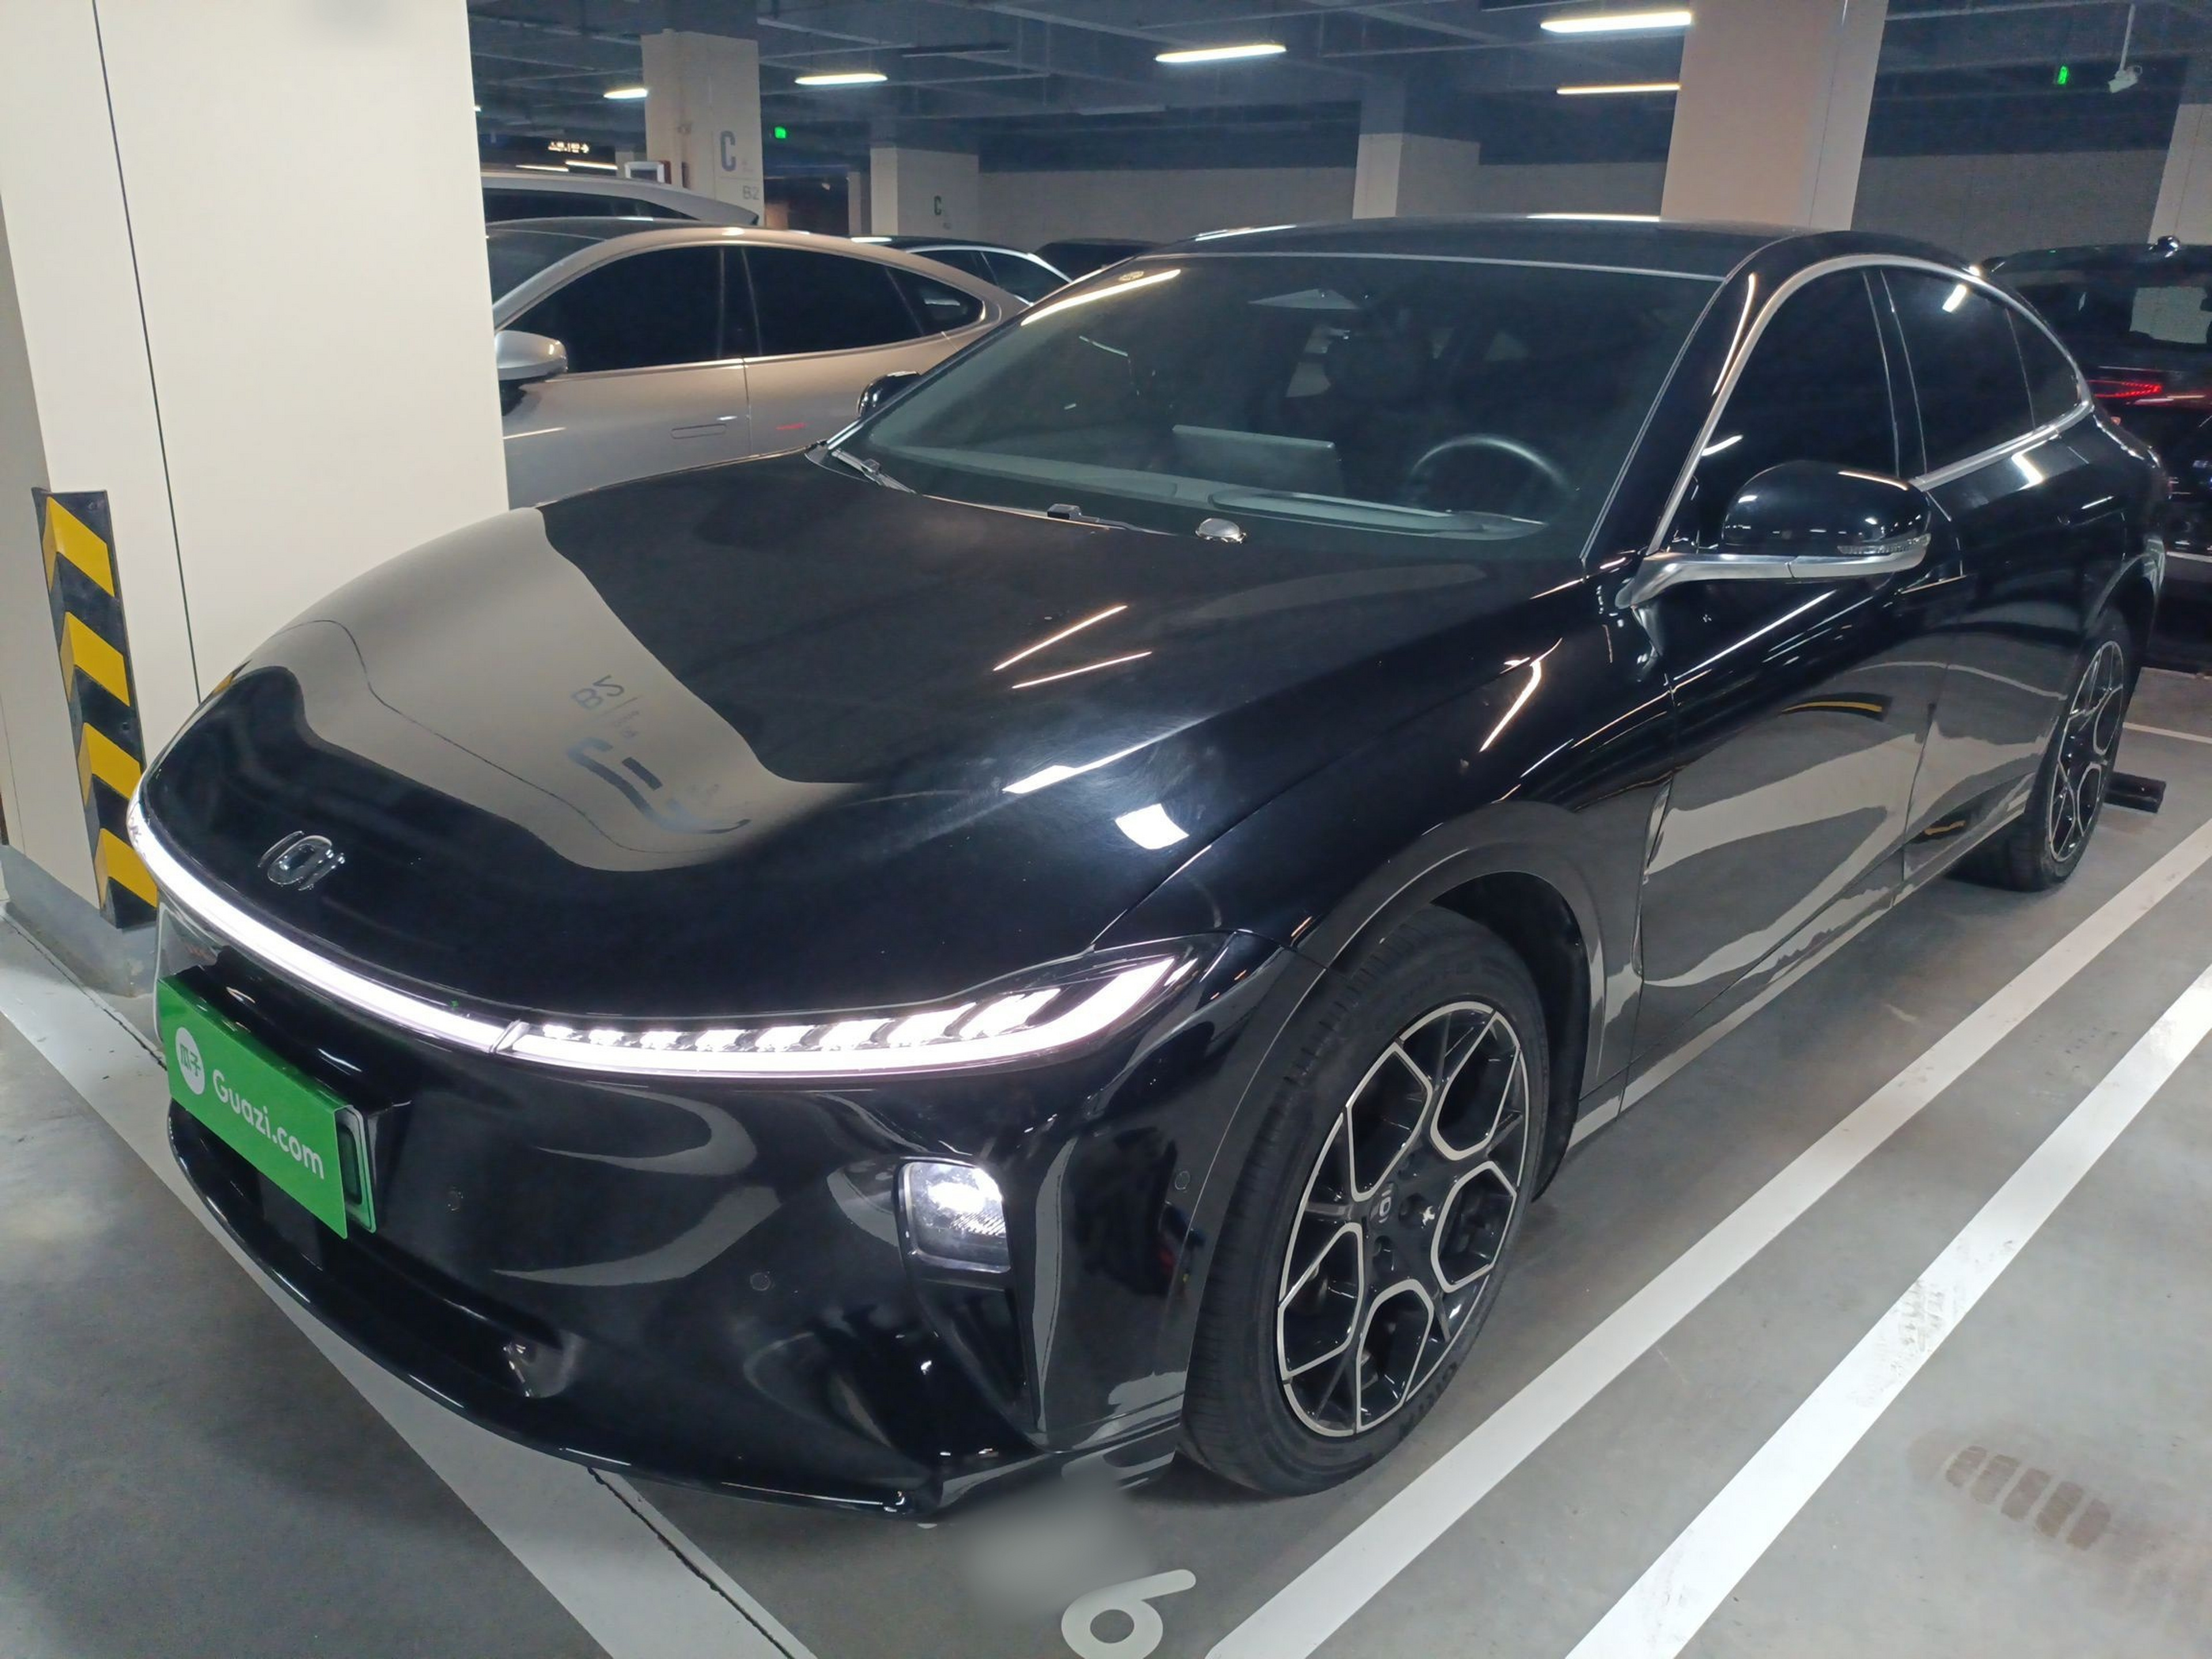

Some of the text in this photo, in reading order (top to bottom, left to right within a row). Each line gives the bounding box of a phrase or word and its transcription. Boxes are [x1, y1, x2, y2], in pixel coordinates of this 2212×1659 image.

[720, 130, 736, 172] C
[743, 184, 760, 200] B2
[934, 196, 942, 215] C
[180, 1043, 201, 1077] 瓜子
[213, 1069, 325, 1180] Guazi.com
